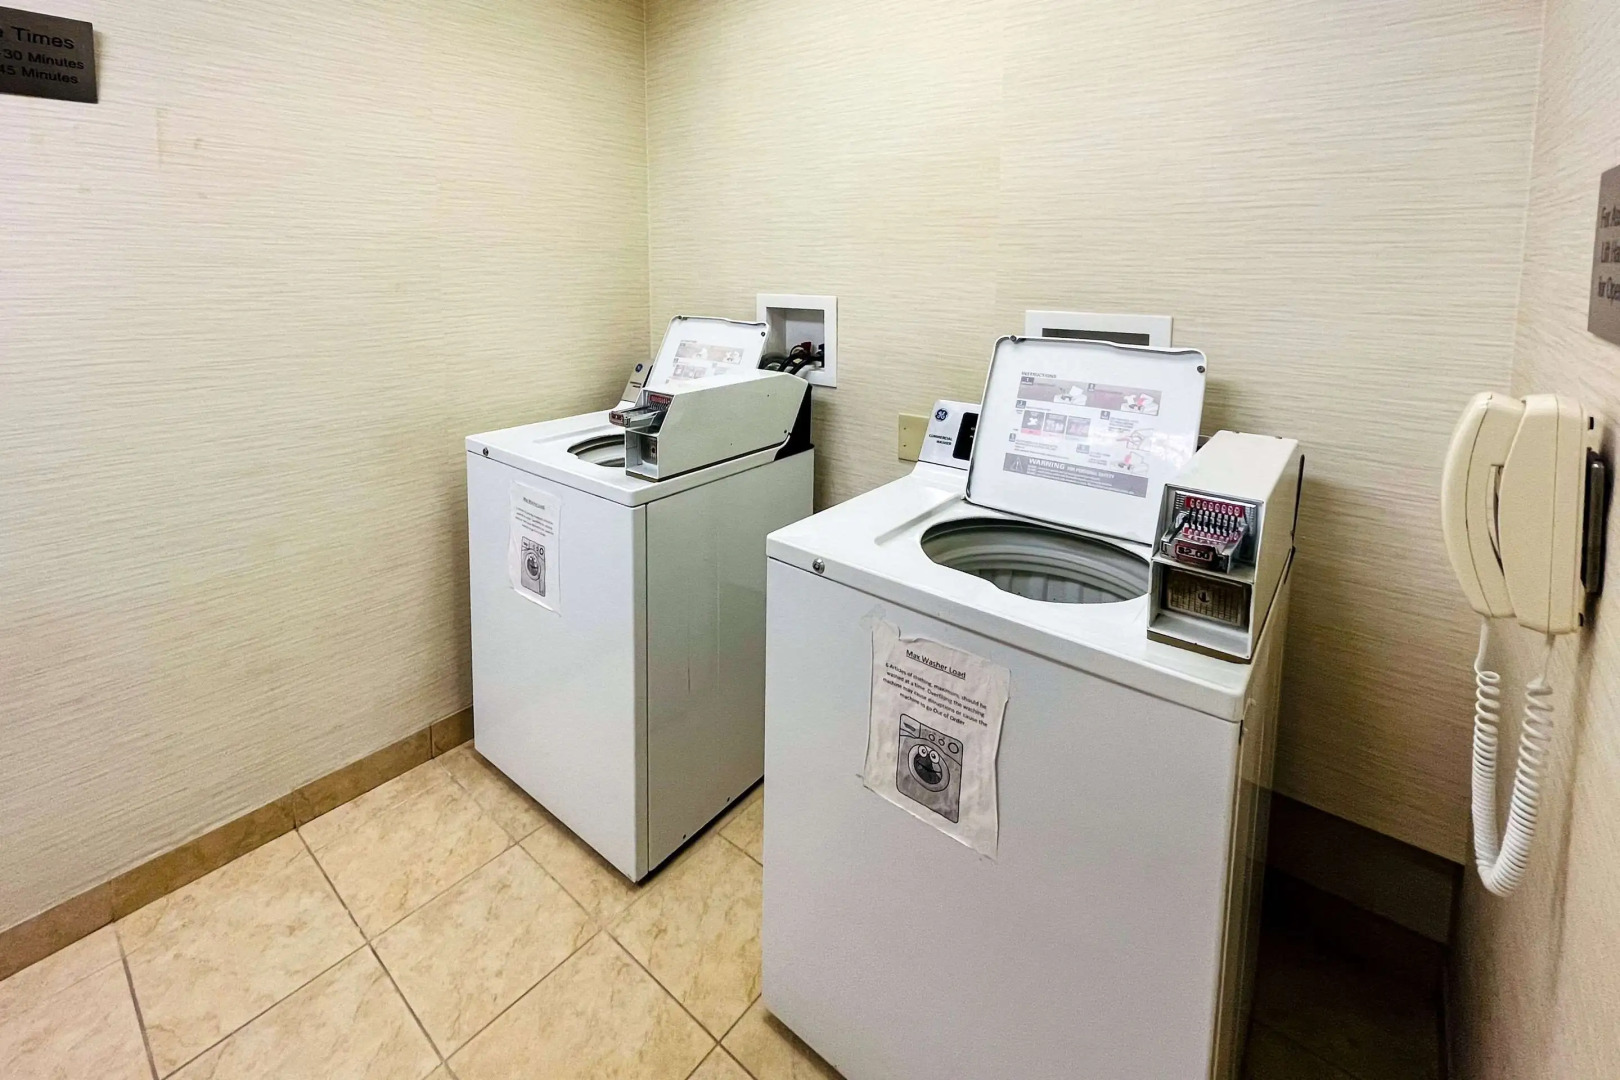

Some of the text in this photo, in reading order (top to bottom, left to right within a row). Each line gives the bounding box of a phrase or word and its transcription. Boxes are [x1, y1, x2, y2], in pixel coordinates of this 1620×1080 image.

[10, 26, 75, 49] Times
[28, 52, 85, 69] Minutes
[21, 66, 79, 84] Minutes
[1029, 458, 1065, 470] WARNING
[1178, 546, 1210, 560] $2.00
[906, 649, 966, 680] Max Washer Load
